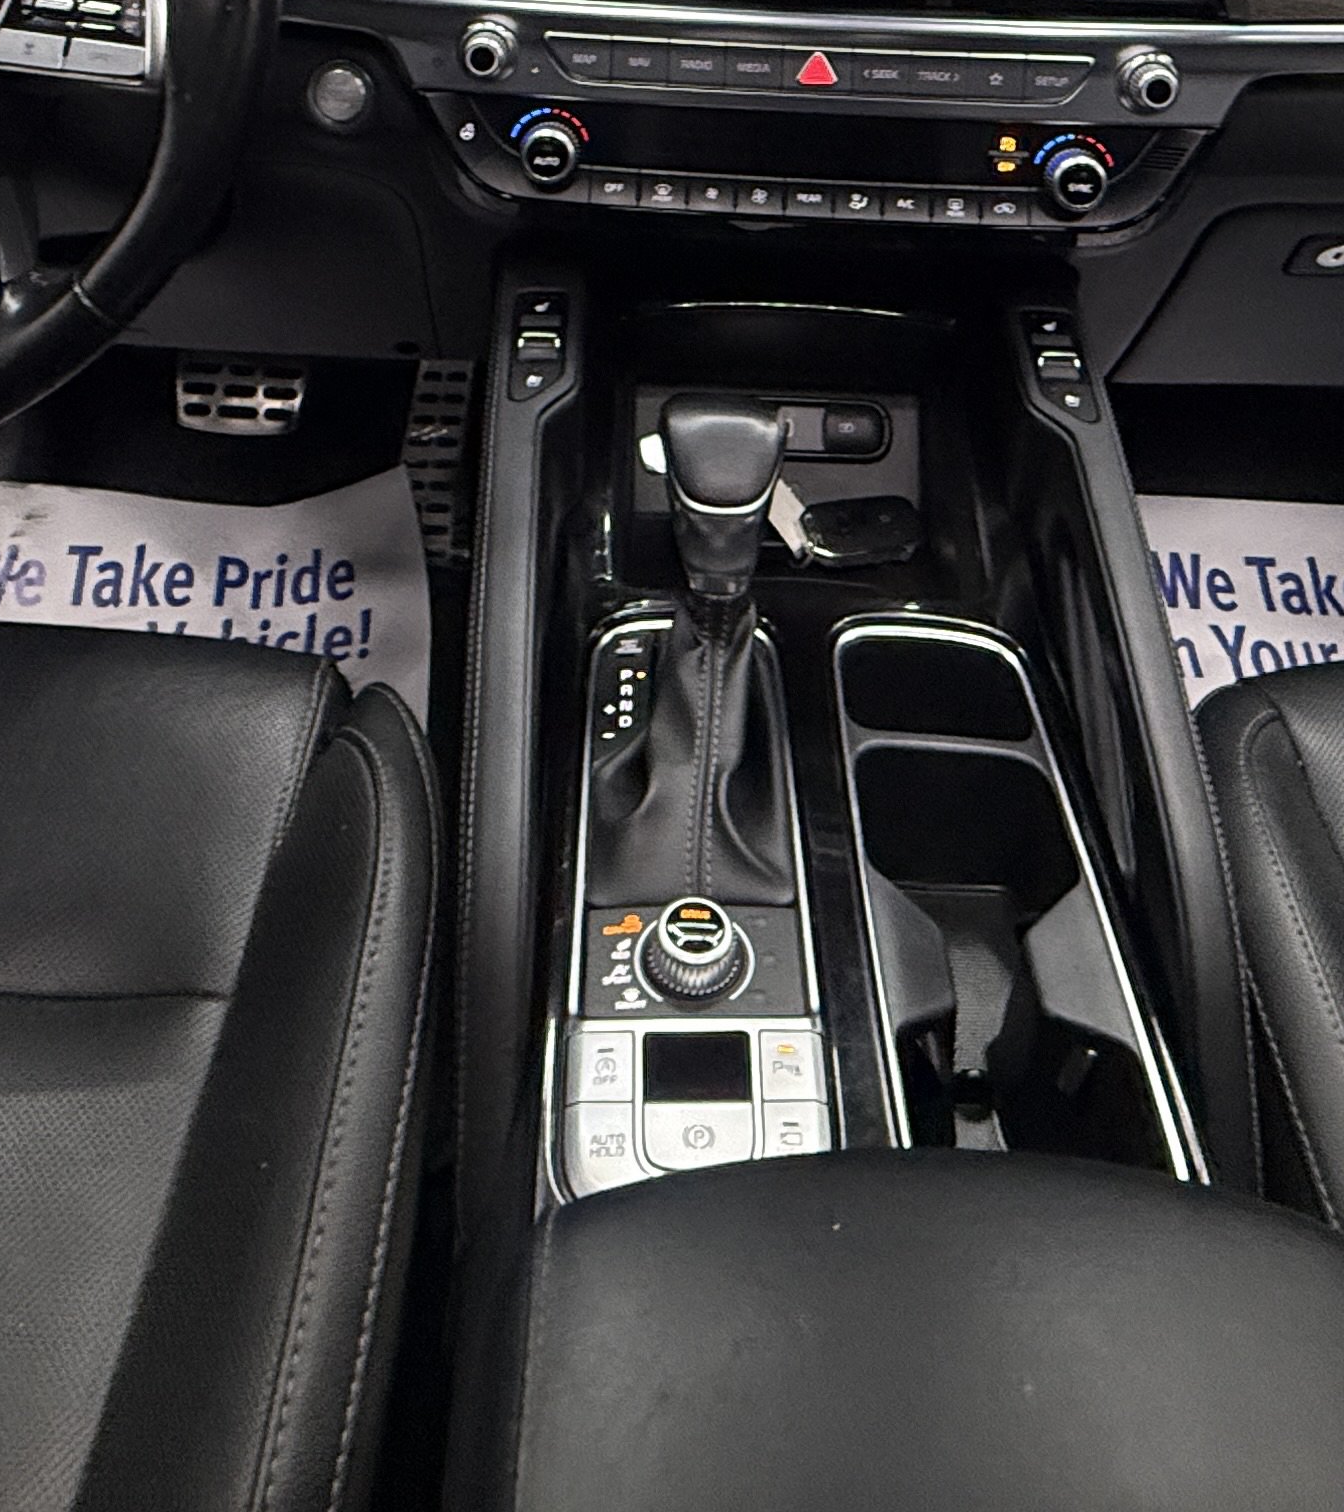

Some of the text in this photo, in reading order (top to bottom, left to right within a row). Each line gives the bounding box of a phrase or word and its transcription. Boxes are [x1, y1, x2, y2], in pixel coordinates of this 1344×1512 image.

[680, 59, 713, 71] RADIO
[736, 62, 771, 73] MEDIA
[1034, 75, 1069, 87] SETUP
[604, 182, 624, 192] OFF
[796, 193, 822, 204] REAR
[66, 544, 195, 607] Take
[213, 549, 355, 609] Pride
[1150, 551, 1238, 611] We
[593, 1075, 618, 1086] OFF
[590, 1133, 626, 1146] AUTO
[589, 1146, 625, 1157] HOLD
